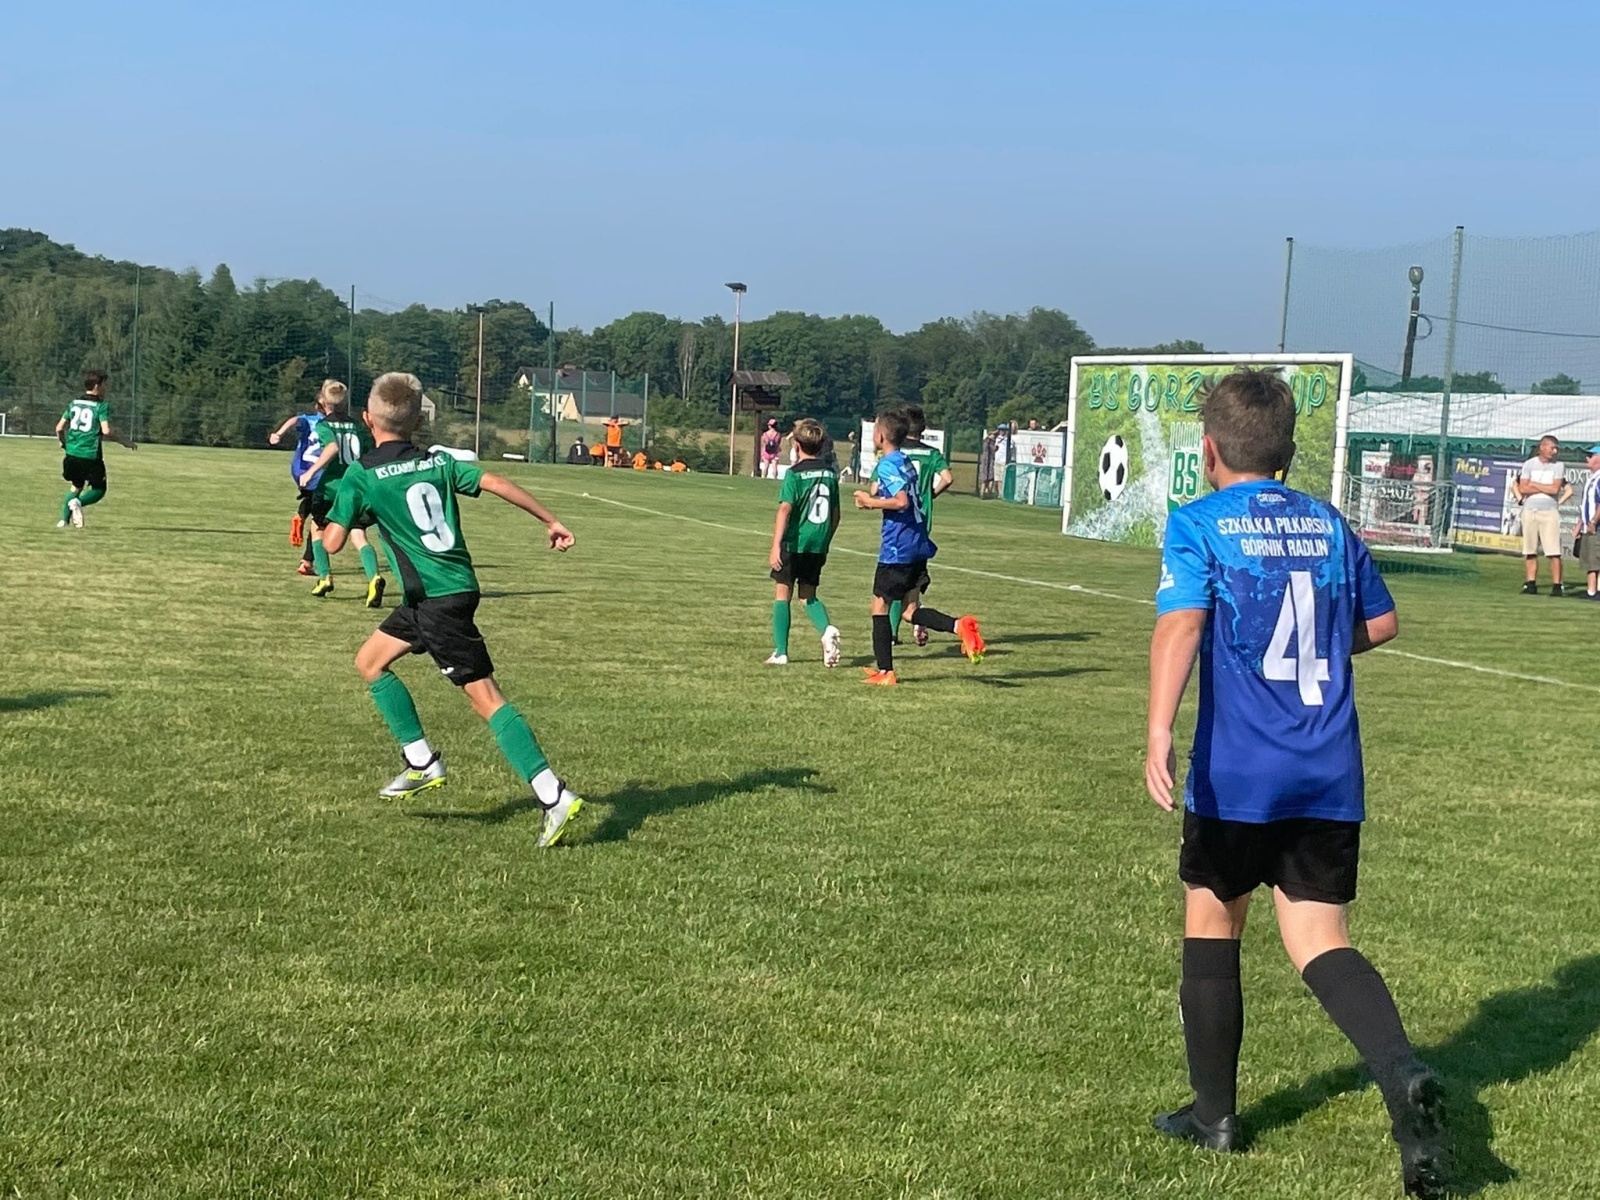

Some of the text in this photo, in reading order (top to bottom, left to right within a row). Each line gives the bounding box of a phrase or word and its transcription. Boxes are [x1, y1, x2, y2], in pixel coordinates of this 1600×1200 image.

[1090, 373, 1118, 410] BS
[70, 405, 93, 432] 29
[336, 432, 360, 465] 10
[1173, 451, 1199, 497] BS
[406, 482, 455, 552] 9
[808, 483, 830, 524] 6
[1240, 536, 1329, 557] GÓRNIK RADLIN
[1262, 571, 1331, 706] 4
